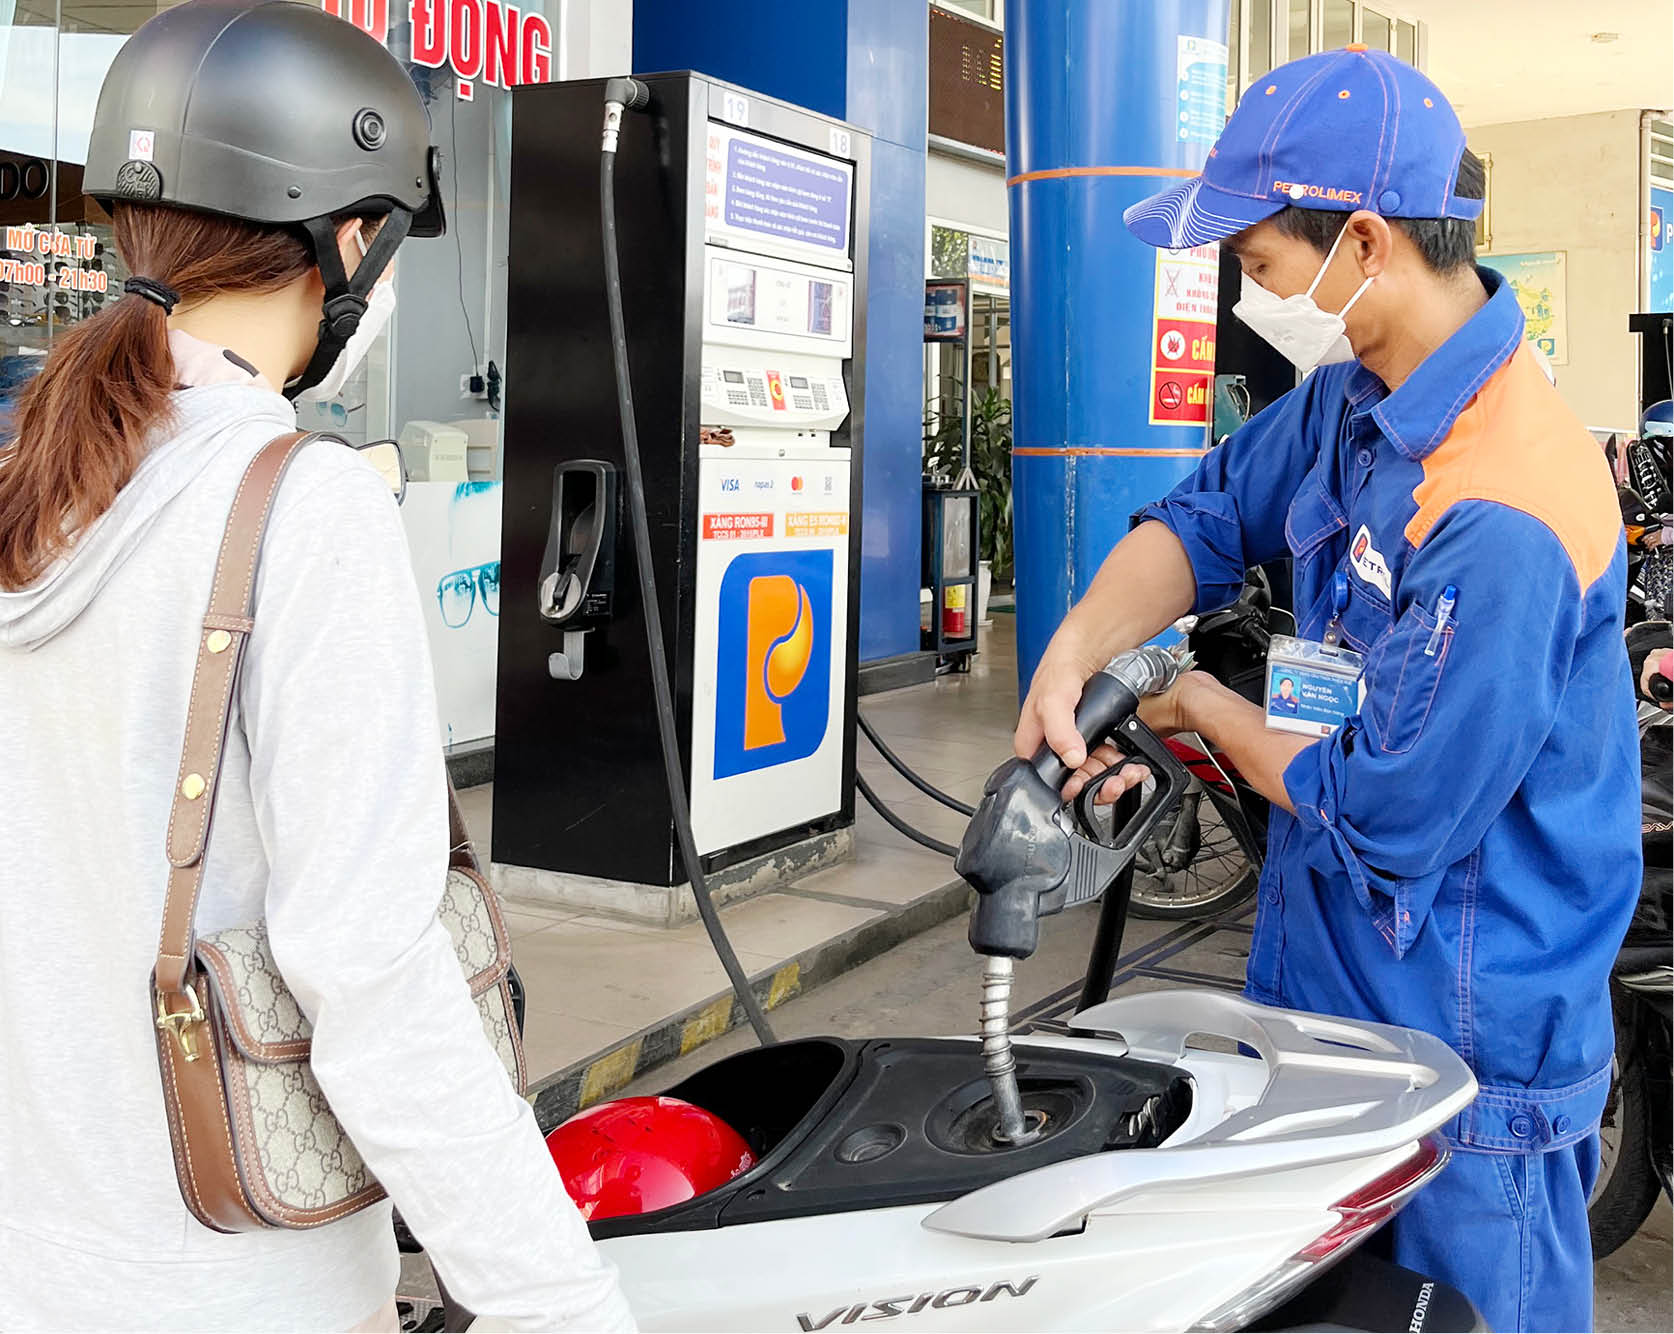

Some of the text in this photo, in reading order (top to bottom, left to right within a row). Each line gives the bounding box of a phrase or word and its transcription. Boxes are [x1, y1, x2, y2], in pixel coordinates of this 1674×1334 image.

[728, 97, 746, 121] 19
[832, 132, 848, 153] 18
[1272, 180, 1363, 205] PEROLIMEX
[59, 266, 108, 293] 21h30
[720, 478, 740, 491] VISA
[796, 1274, 1041, 1332] VISION
[1409, 1283, 1434, 1333] HONDA
